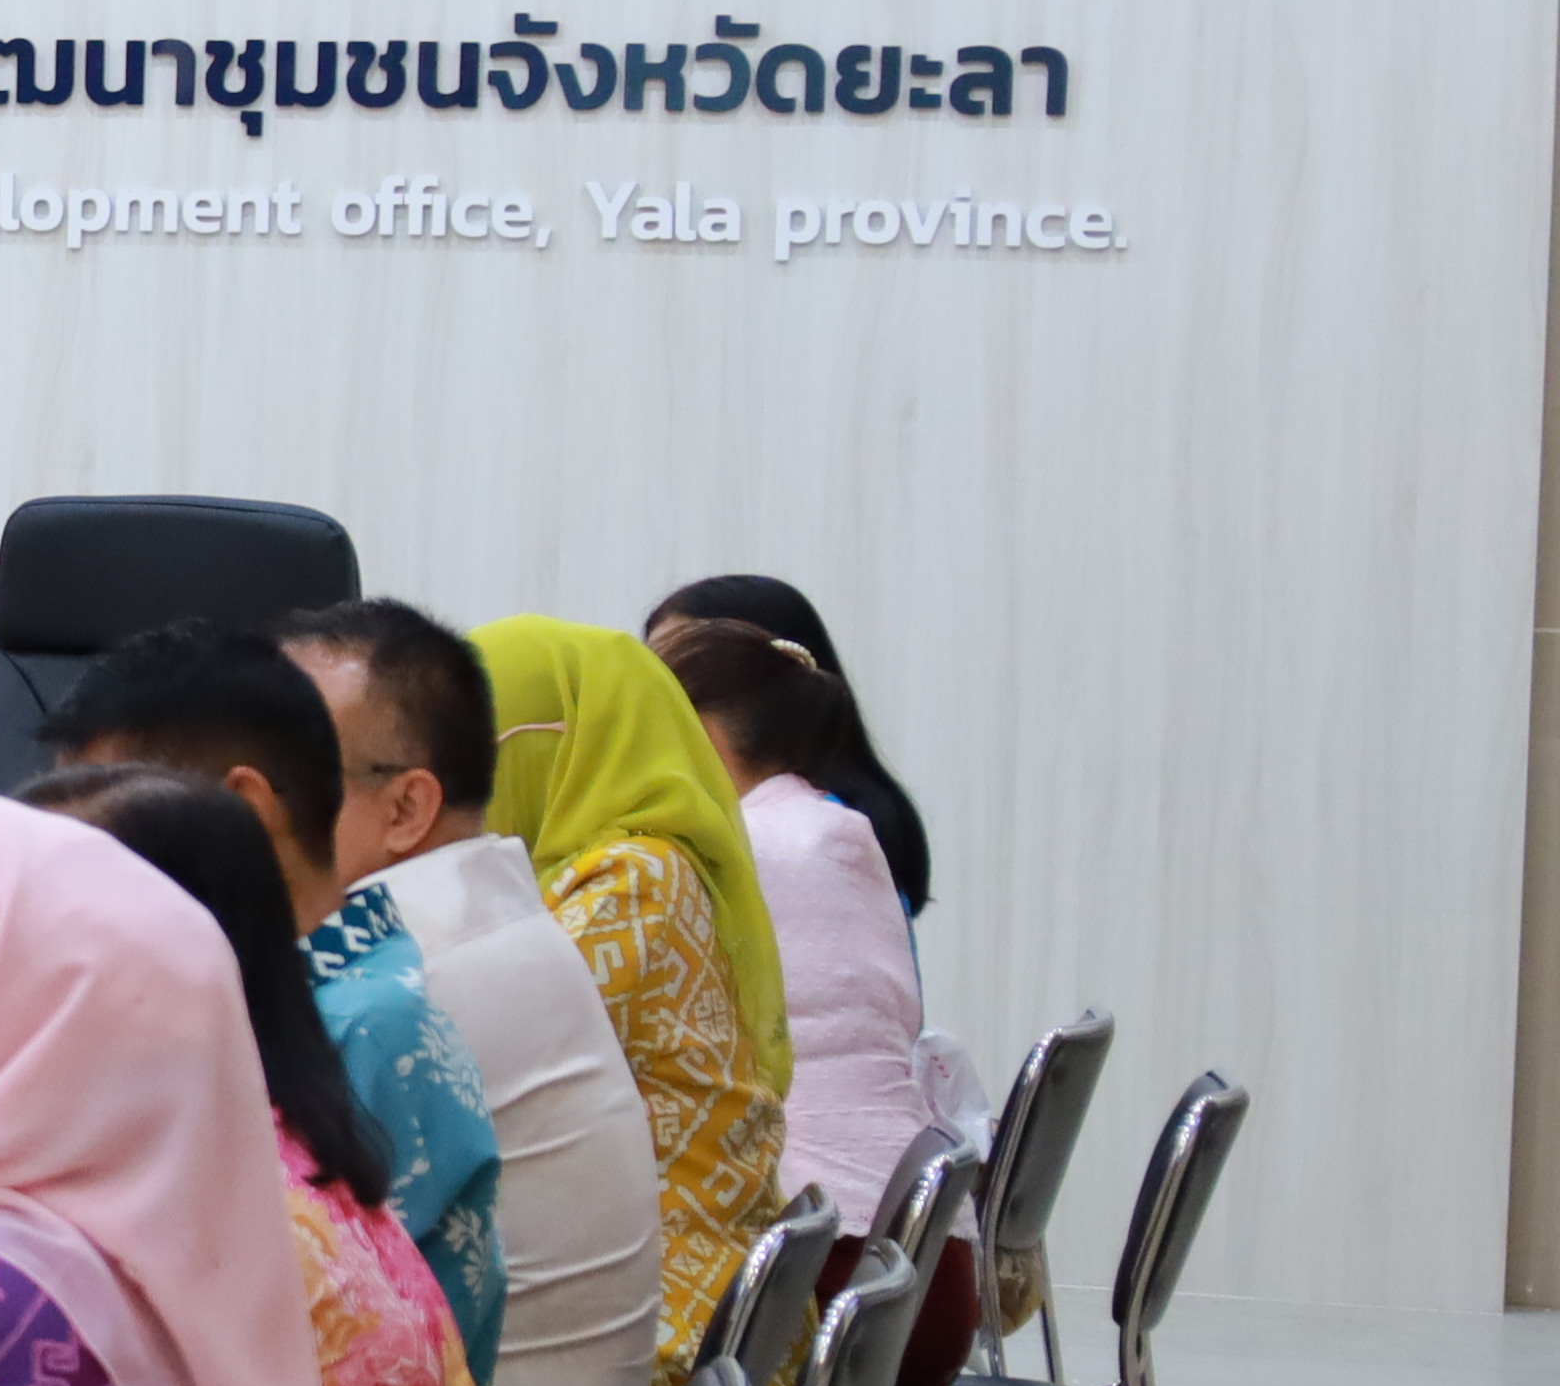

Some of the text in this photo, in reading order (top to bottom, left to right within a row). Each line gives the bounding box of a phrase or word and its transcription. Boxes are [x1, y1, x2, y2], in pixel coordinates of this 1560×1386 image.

[330, 173, 554, 250] office,
[585, 179, 742, 243] Yala
[774, 186, 1130, 262] province.
